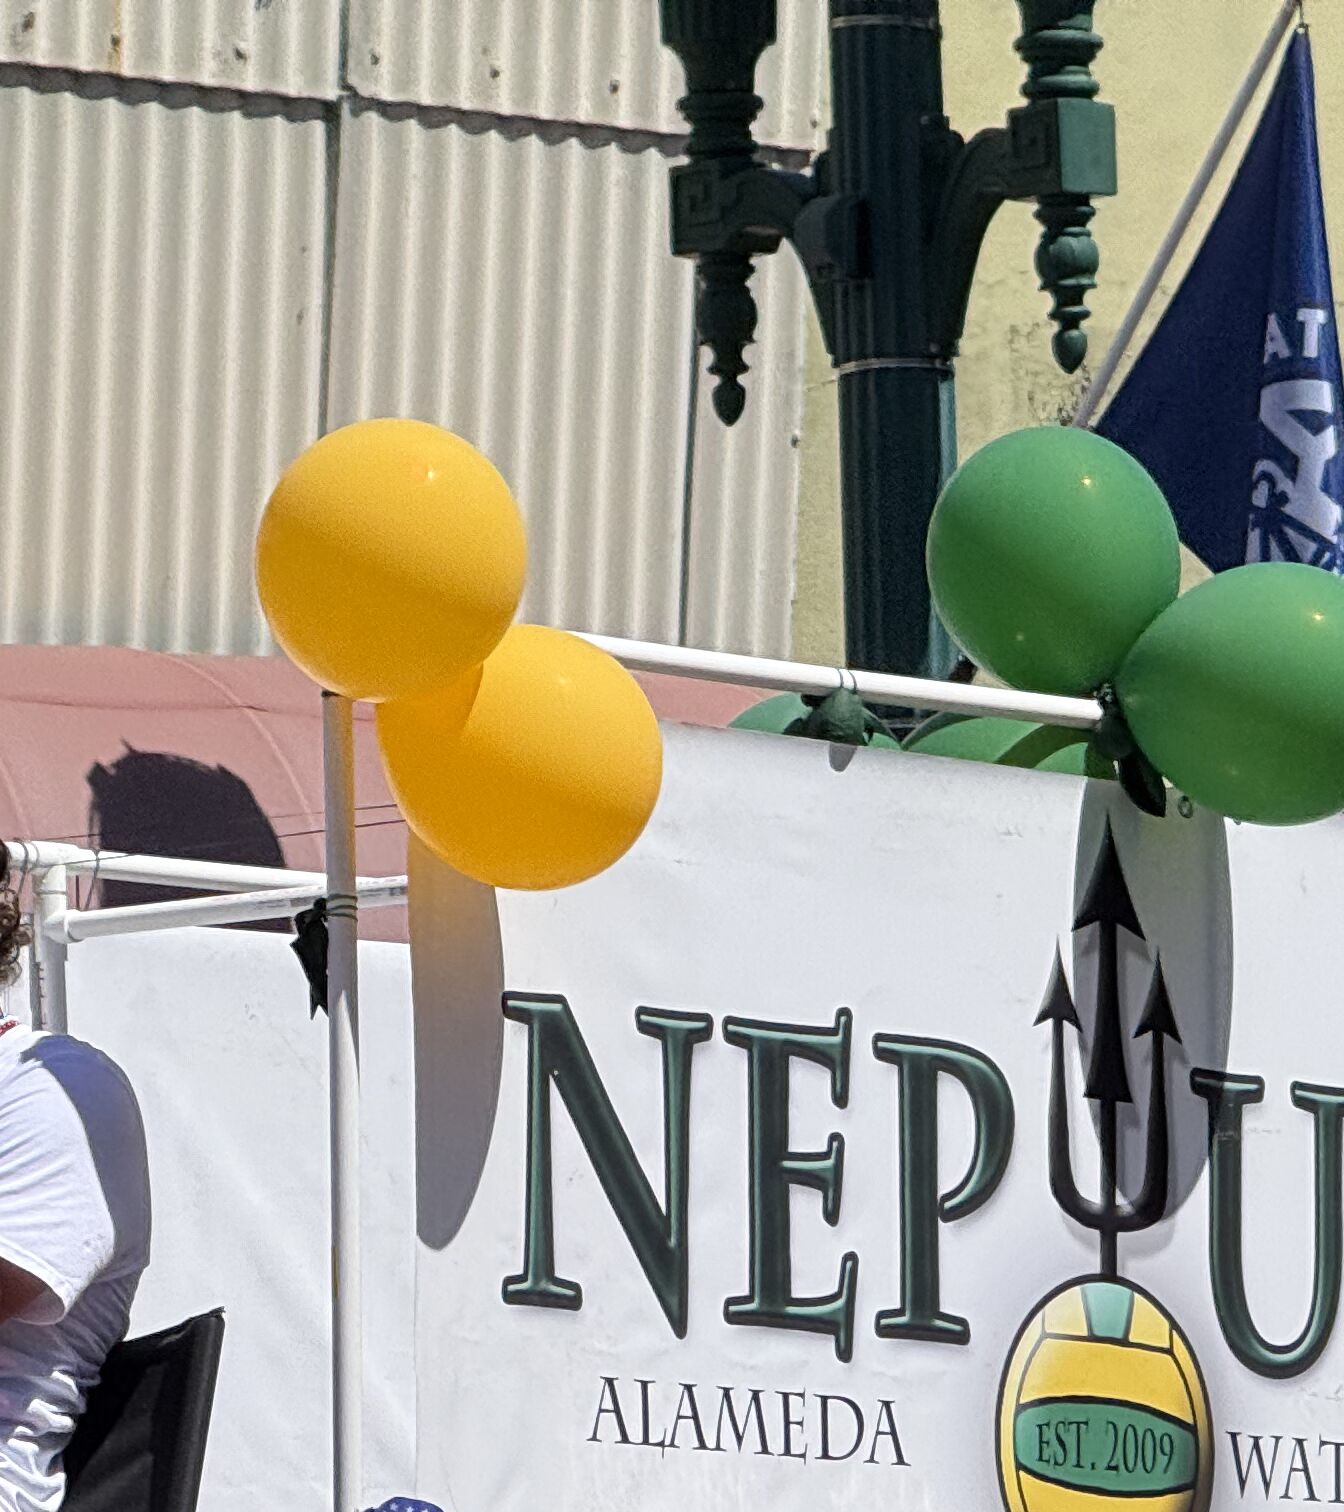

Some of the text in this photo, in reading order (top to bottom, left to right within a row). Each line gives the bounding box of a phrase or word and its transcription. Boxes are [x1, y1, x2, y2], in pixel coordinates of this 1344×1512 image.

[586, 1376, 912, 1467] ALAMEDA
[1035, 1419, 1175, 1475] EST. 2009
